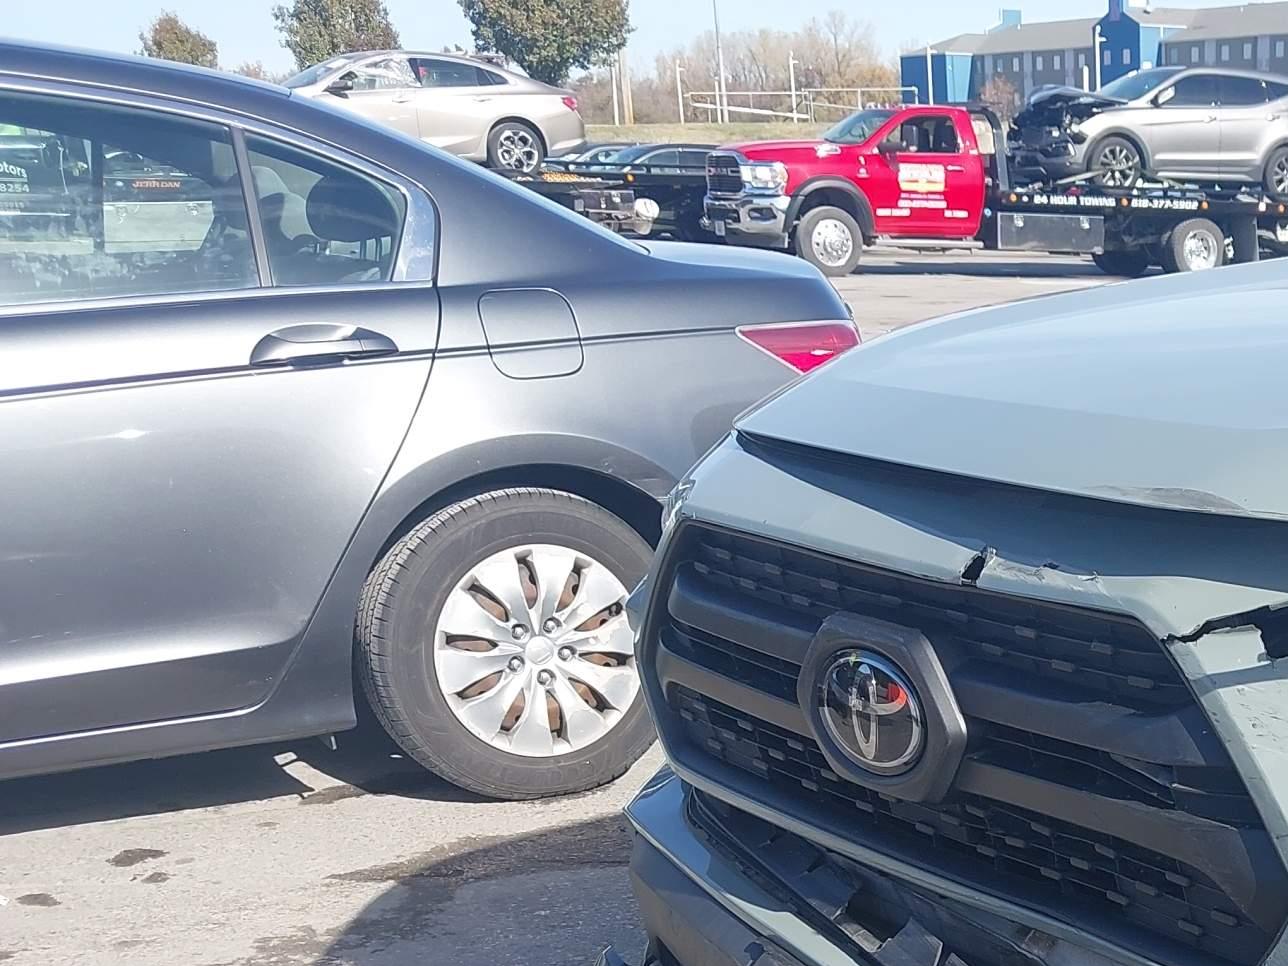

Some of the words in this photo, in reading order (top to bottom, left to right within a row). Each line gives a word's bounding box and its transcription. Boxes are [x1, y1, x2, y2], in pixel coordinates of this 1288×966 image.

[1033, 194, 1048, 205] 24
[1050, 195, 1077, 206] HOUR
[1079, 196, 1116, 207] TOWING
